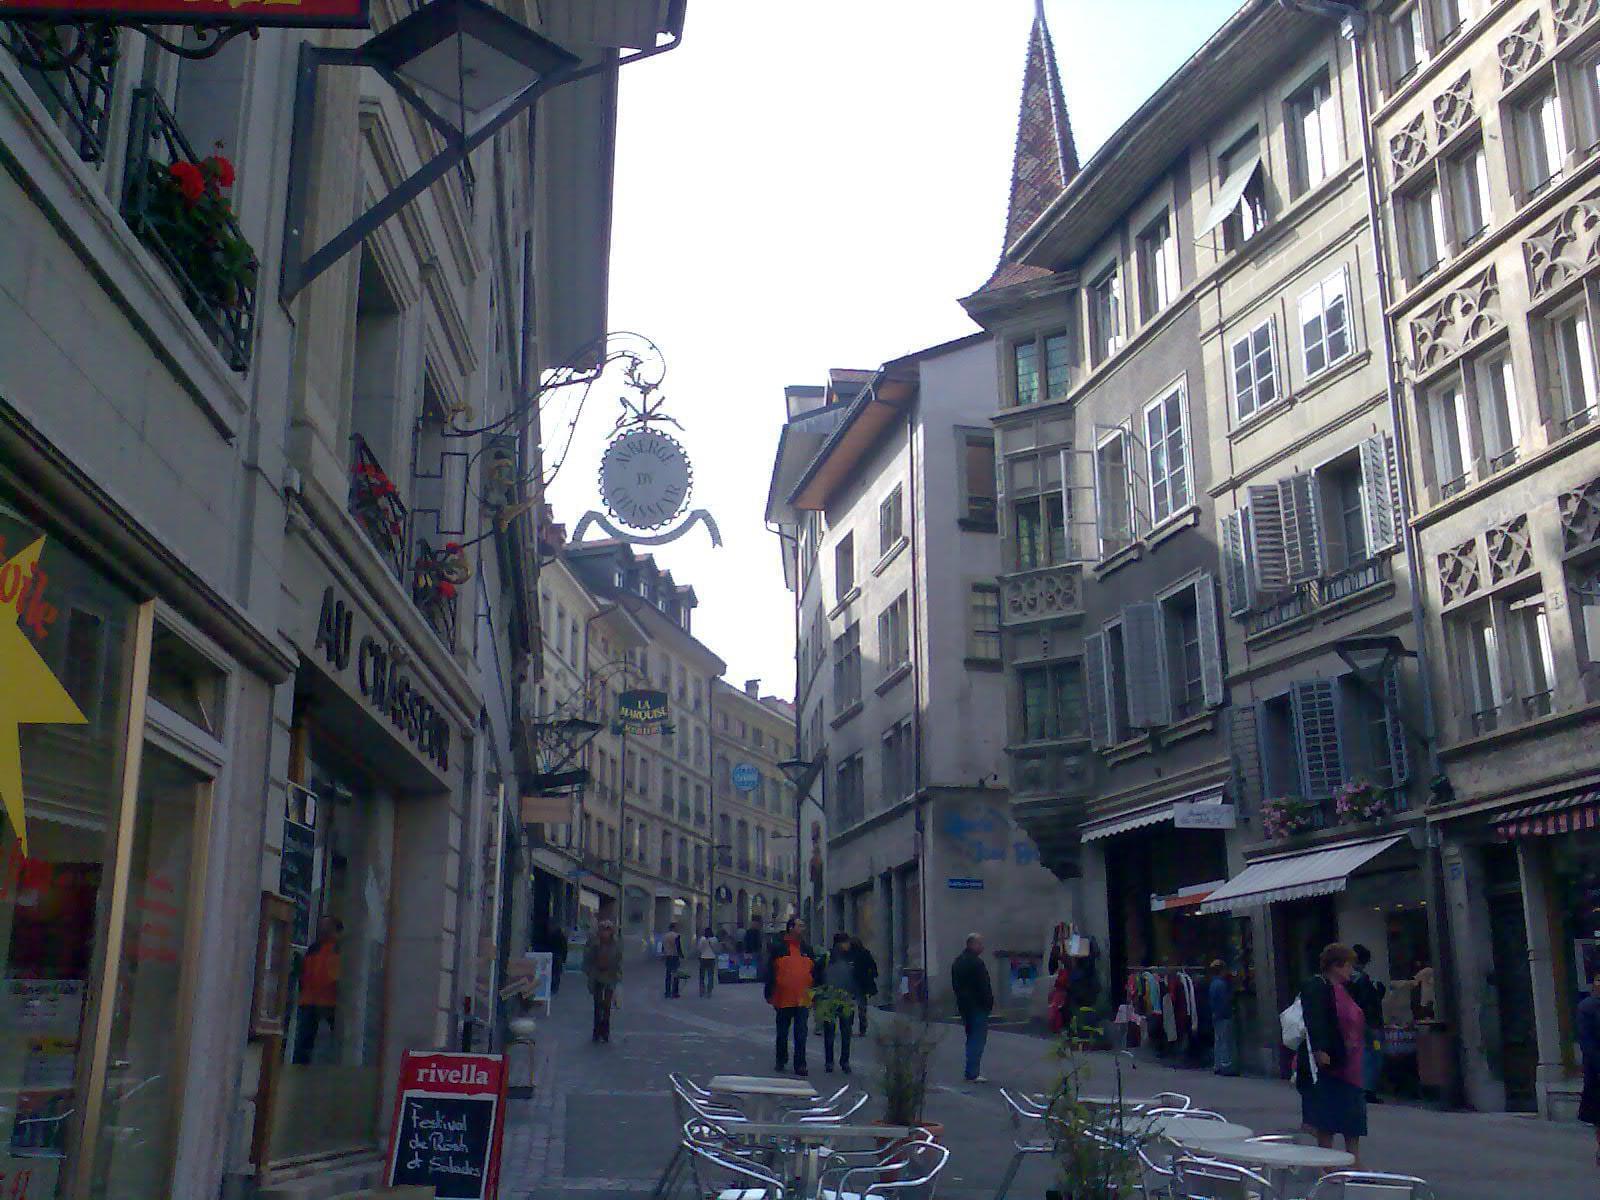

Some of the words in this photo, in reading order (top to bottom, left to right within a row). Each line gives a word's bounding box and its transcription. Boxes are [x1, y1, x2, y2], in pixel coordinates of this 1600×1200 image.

[314, 586, 353, 671] AU
[358, 635, 451, 772] CHASSEUR
[638, 700, 651, 710] LA
[416, 1063, 489, 1086] rivella
[411, 1102, 467, 1132] Festival
[409, 1132, 429, 1150] de
